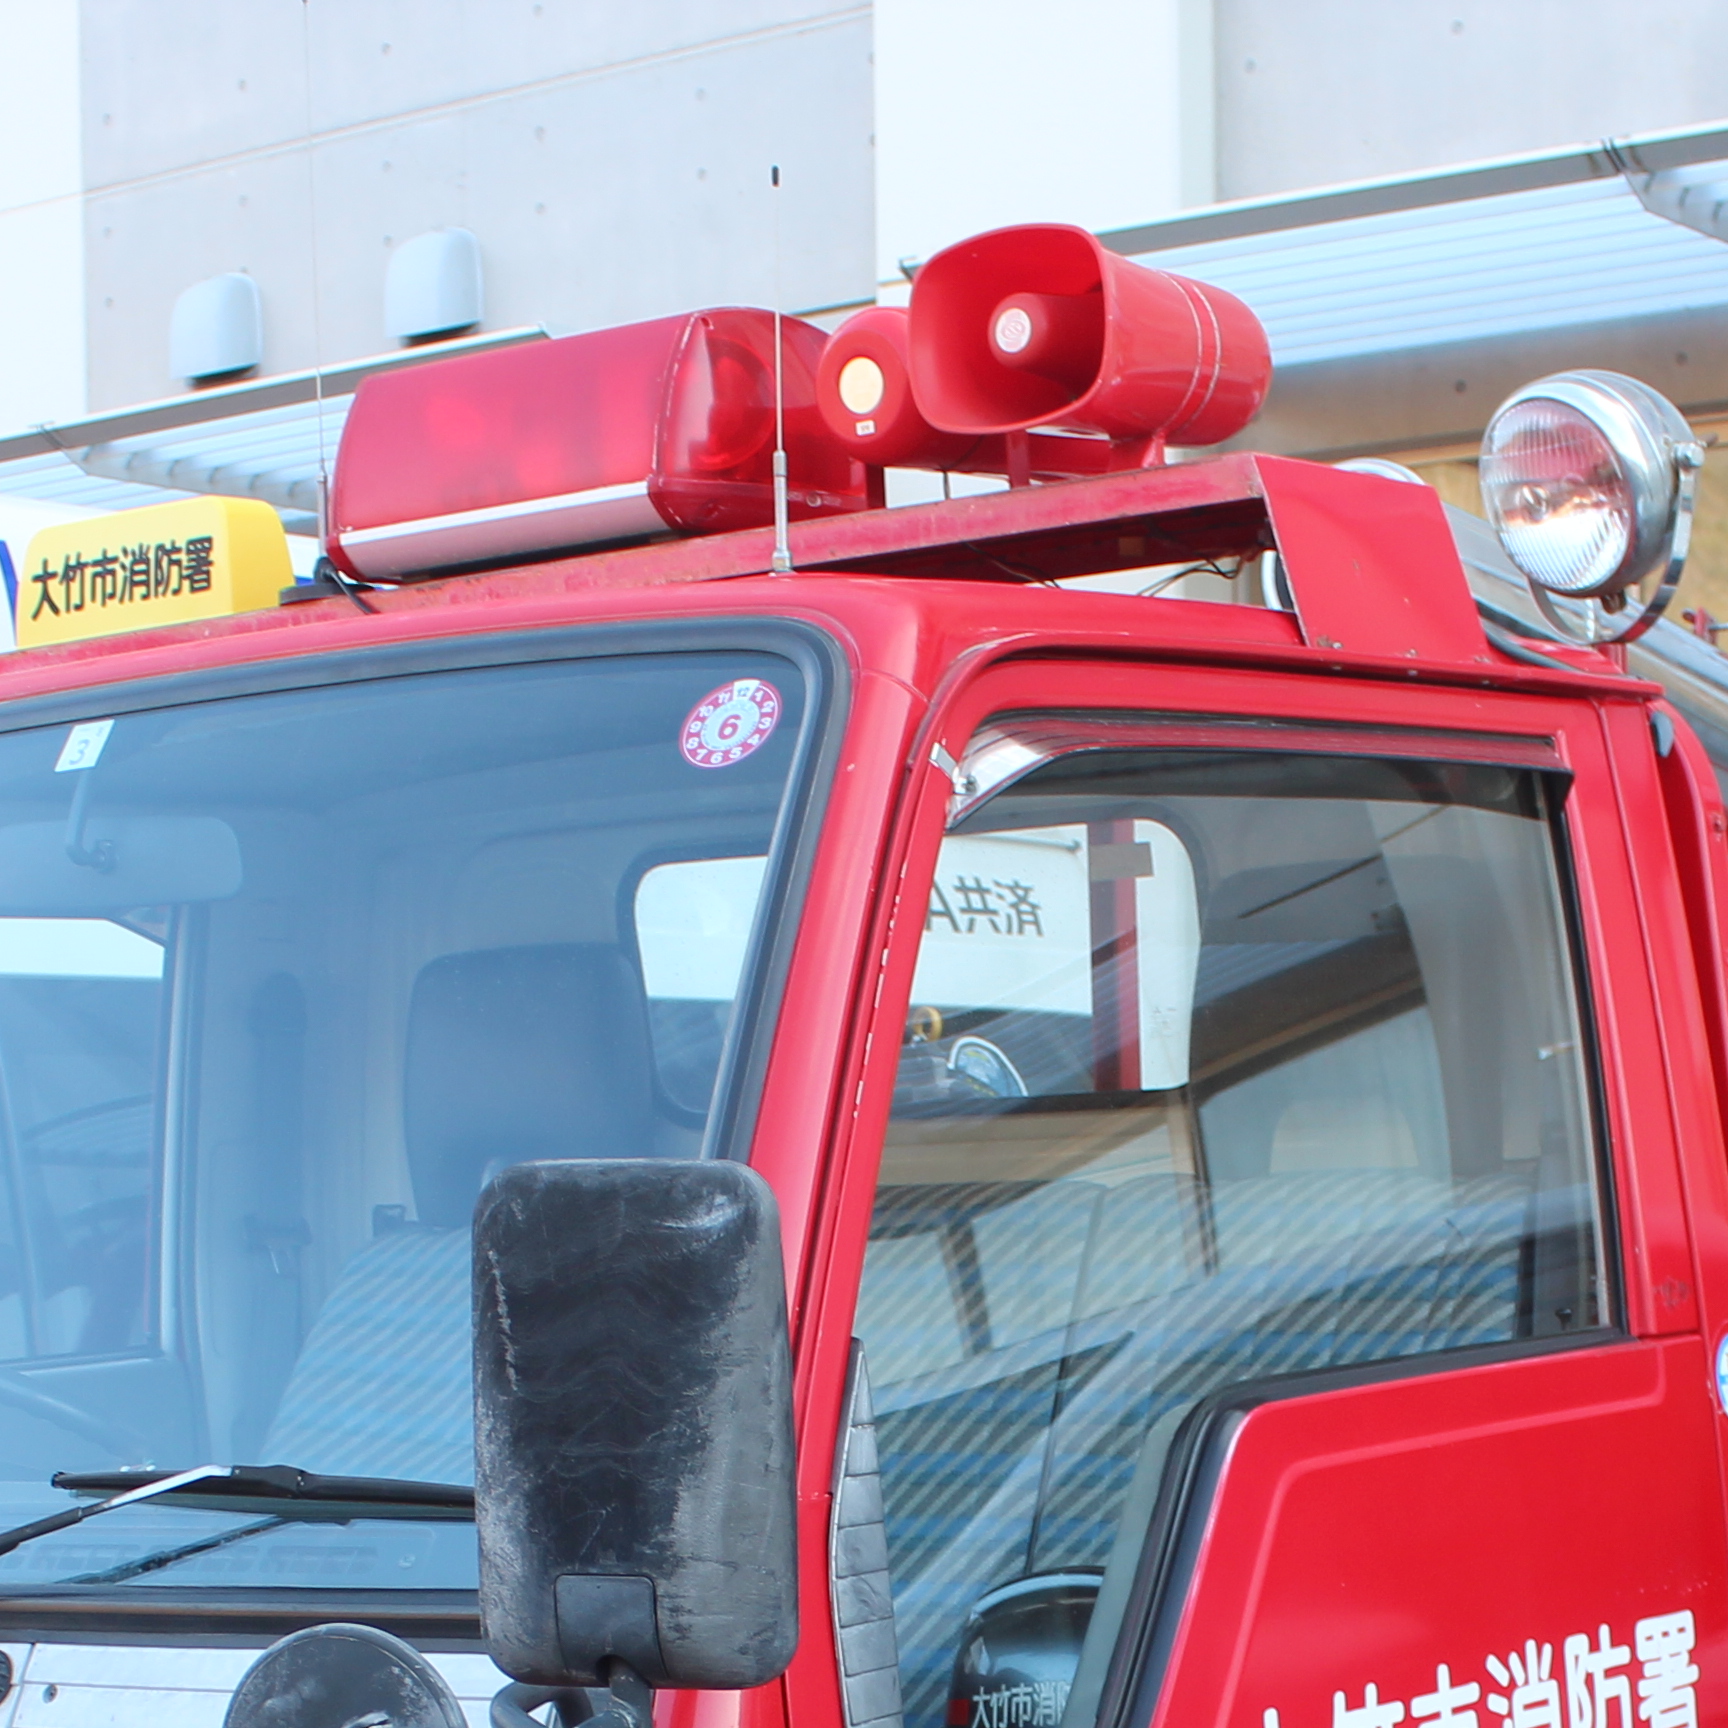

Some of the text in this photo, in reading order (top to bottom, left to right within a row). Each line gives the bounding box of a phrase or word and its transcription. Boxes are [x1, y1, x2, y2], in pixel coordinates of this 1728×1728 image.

[30, 535, 215, 621] 大竹市消防署
[761, 701, 774, 712] 2
[689, 721, 702, 733] 9
[718, 714, 742, 740] 6
[759, 717, 772, 729] 3
[69, 739, 90, 766] 3
[695, 749, 708, 760] 7
[710, 752, 724, 764] 6
[728, 747, 743, 758] 5
